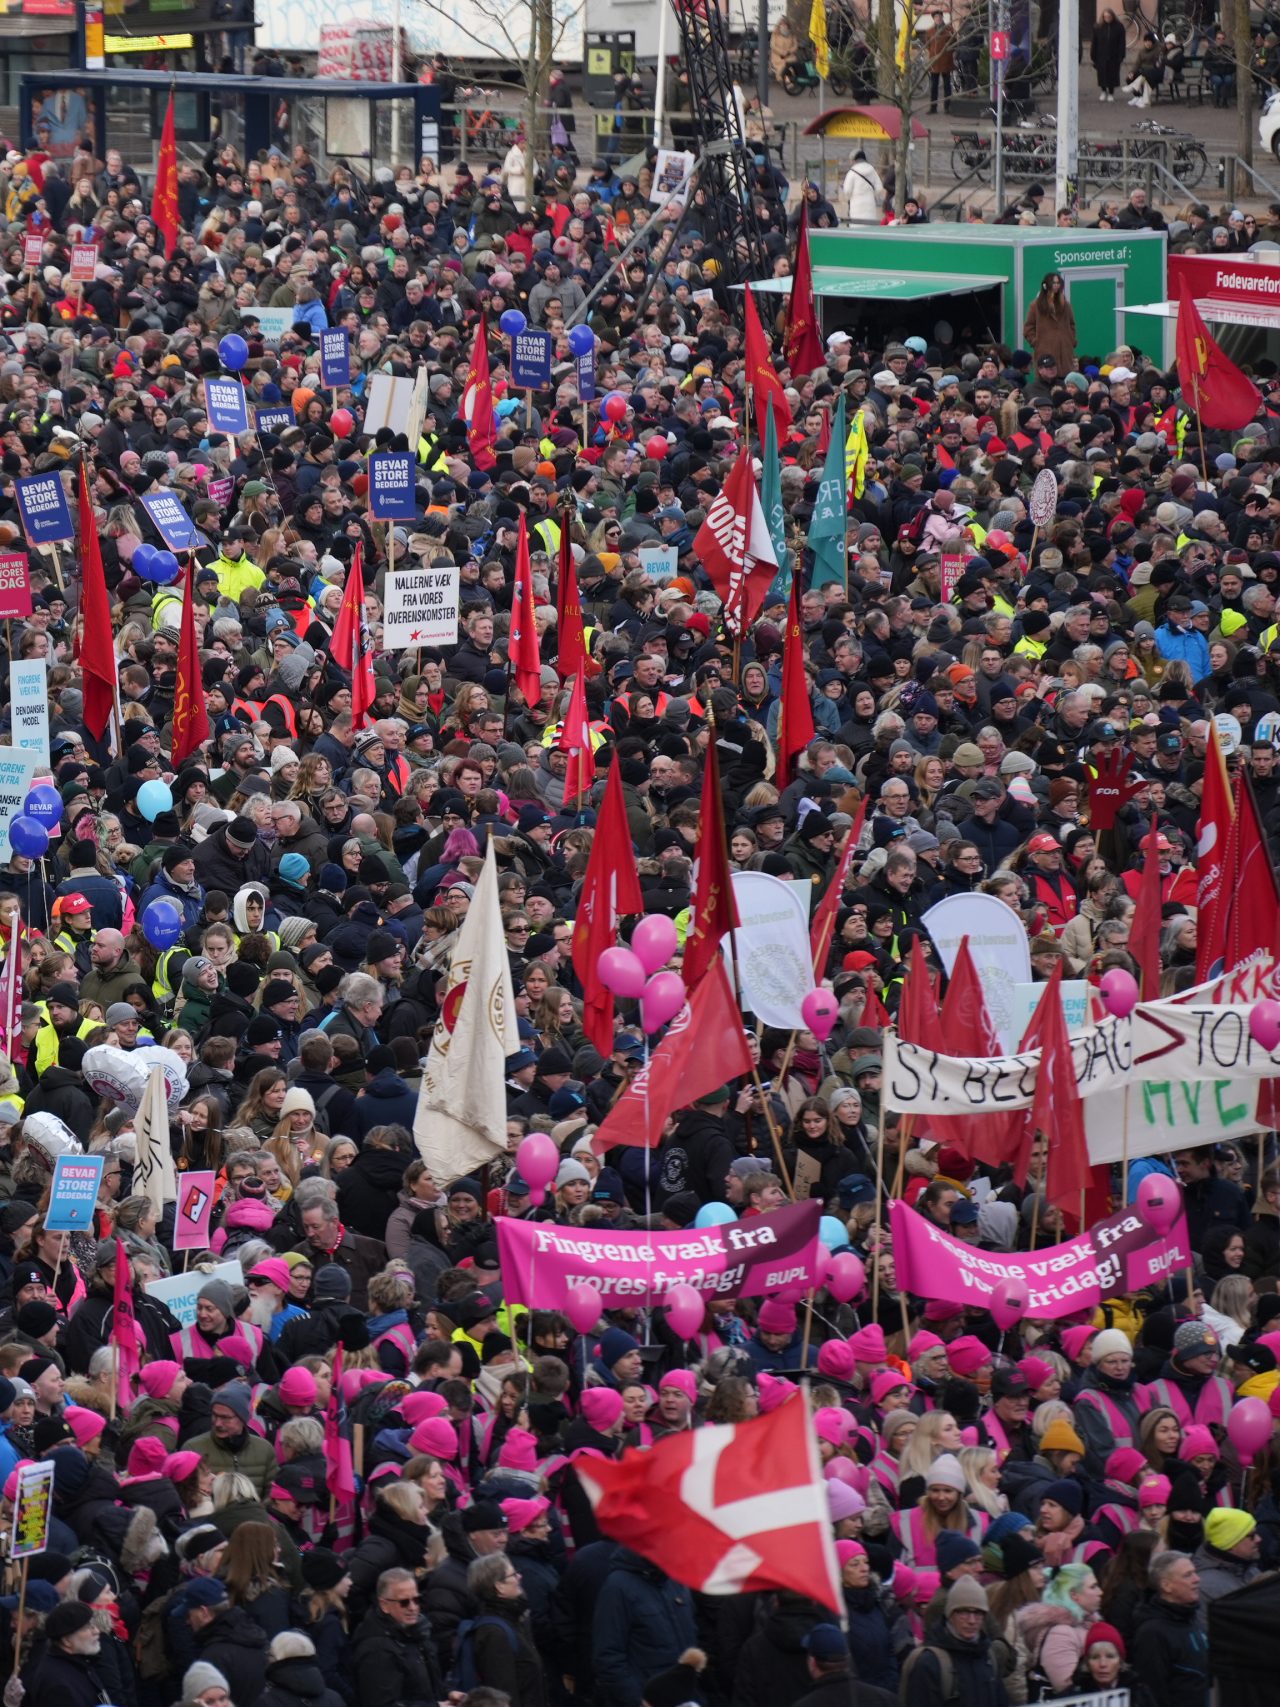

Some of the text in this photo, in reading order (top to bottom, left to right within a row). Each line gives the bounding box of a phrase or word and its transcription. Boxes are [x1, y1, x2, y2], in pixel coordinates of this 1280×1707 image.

[1054, 248, 1114, 265] Sponsoreret
[324, 334, 345, 344] BEVAR
[516, 335, 545, 347] BEVAR
[324, 343, 345, 352] STORE
[516, 345, 545, 356] STORE
[210, 385, 238, 396] BEVAR
[210, 393, 239, 404] STORE
[260, 414, 289, 425] BEVAR
[375, 460, 408, 471] BEVAR
[375, 470, 408, 480] STORE
[21, 479, 56, 497] BEVAR
[375, 480, 408, 489] BEDEDAG
[24, 491, 58, 507] STORE
[148, 497, 176, 511] BEVAR
[27, 501, 60, 515] BEDEDAG
[153, 505, 182, 519] STORE
[158, 513, 186, 526] BEDEDAG
[646, 561, 671, 573] BEVAR
[395, 574, 451, 591] NALLERNE VÆK
[402, 592, 444, 607] FRA VORES
[387, 607, 456, 625] OVERENSKOMSTER
[17, 674, 41, 685] FINGRENE
[15, 704, 45, 717] DEN DANSKE
[22, 715, 40, 726] MODEL
[4, 774, 21, 785] FRA
[1096, 787, 1120, 795] FOA
[29, 803, 52, 811] BEVAR
[964, 1013, 1133, 1104] BEDDAG
[61, 1167, 97, 1179] BEVAR
[58, 1179, 96, 1191] STORE
[56, 1191, 93, 1201] BEDEDAG
[535, 1226, 777, 1263] Fingrene væk fra
[1028, 1240, 1097, 1277] væk
[1097, 1214, 1143, 1249] fra
[1147, 1247, 1185, 1275] BUPL
[565, 1263, 745, 1297] vores fridag!
[765, 1266, 809, 1288] BUPL
[959, 1253, 1124, 1308] vor fridag!
